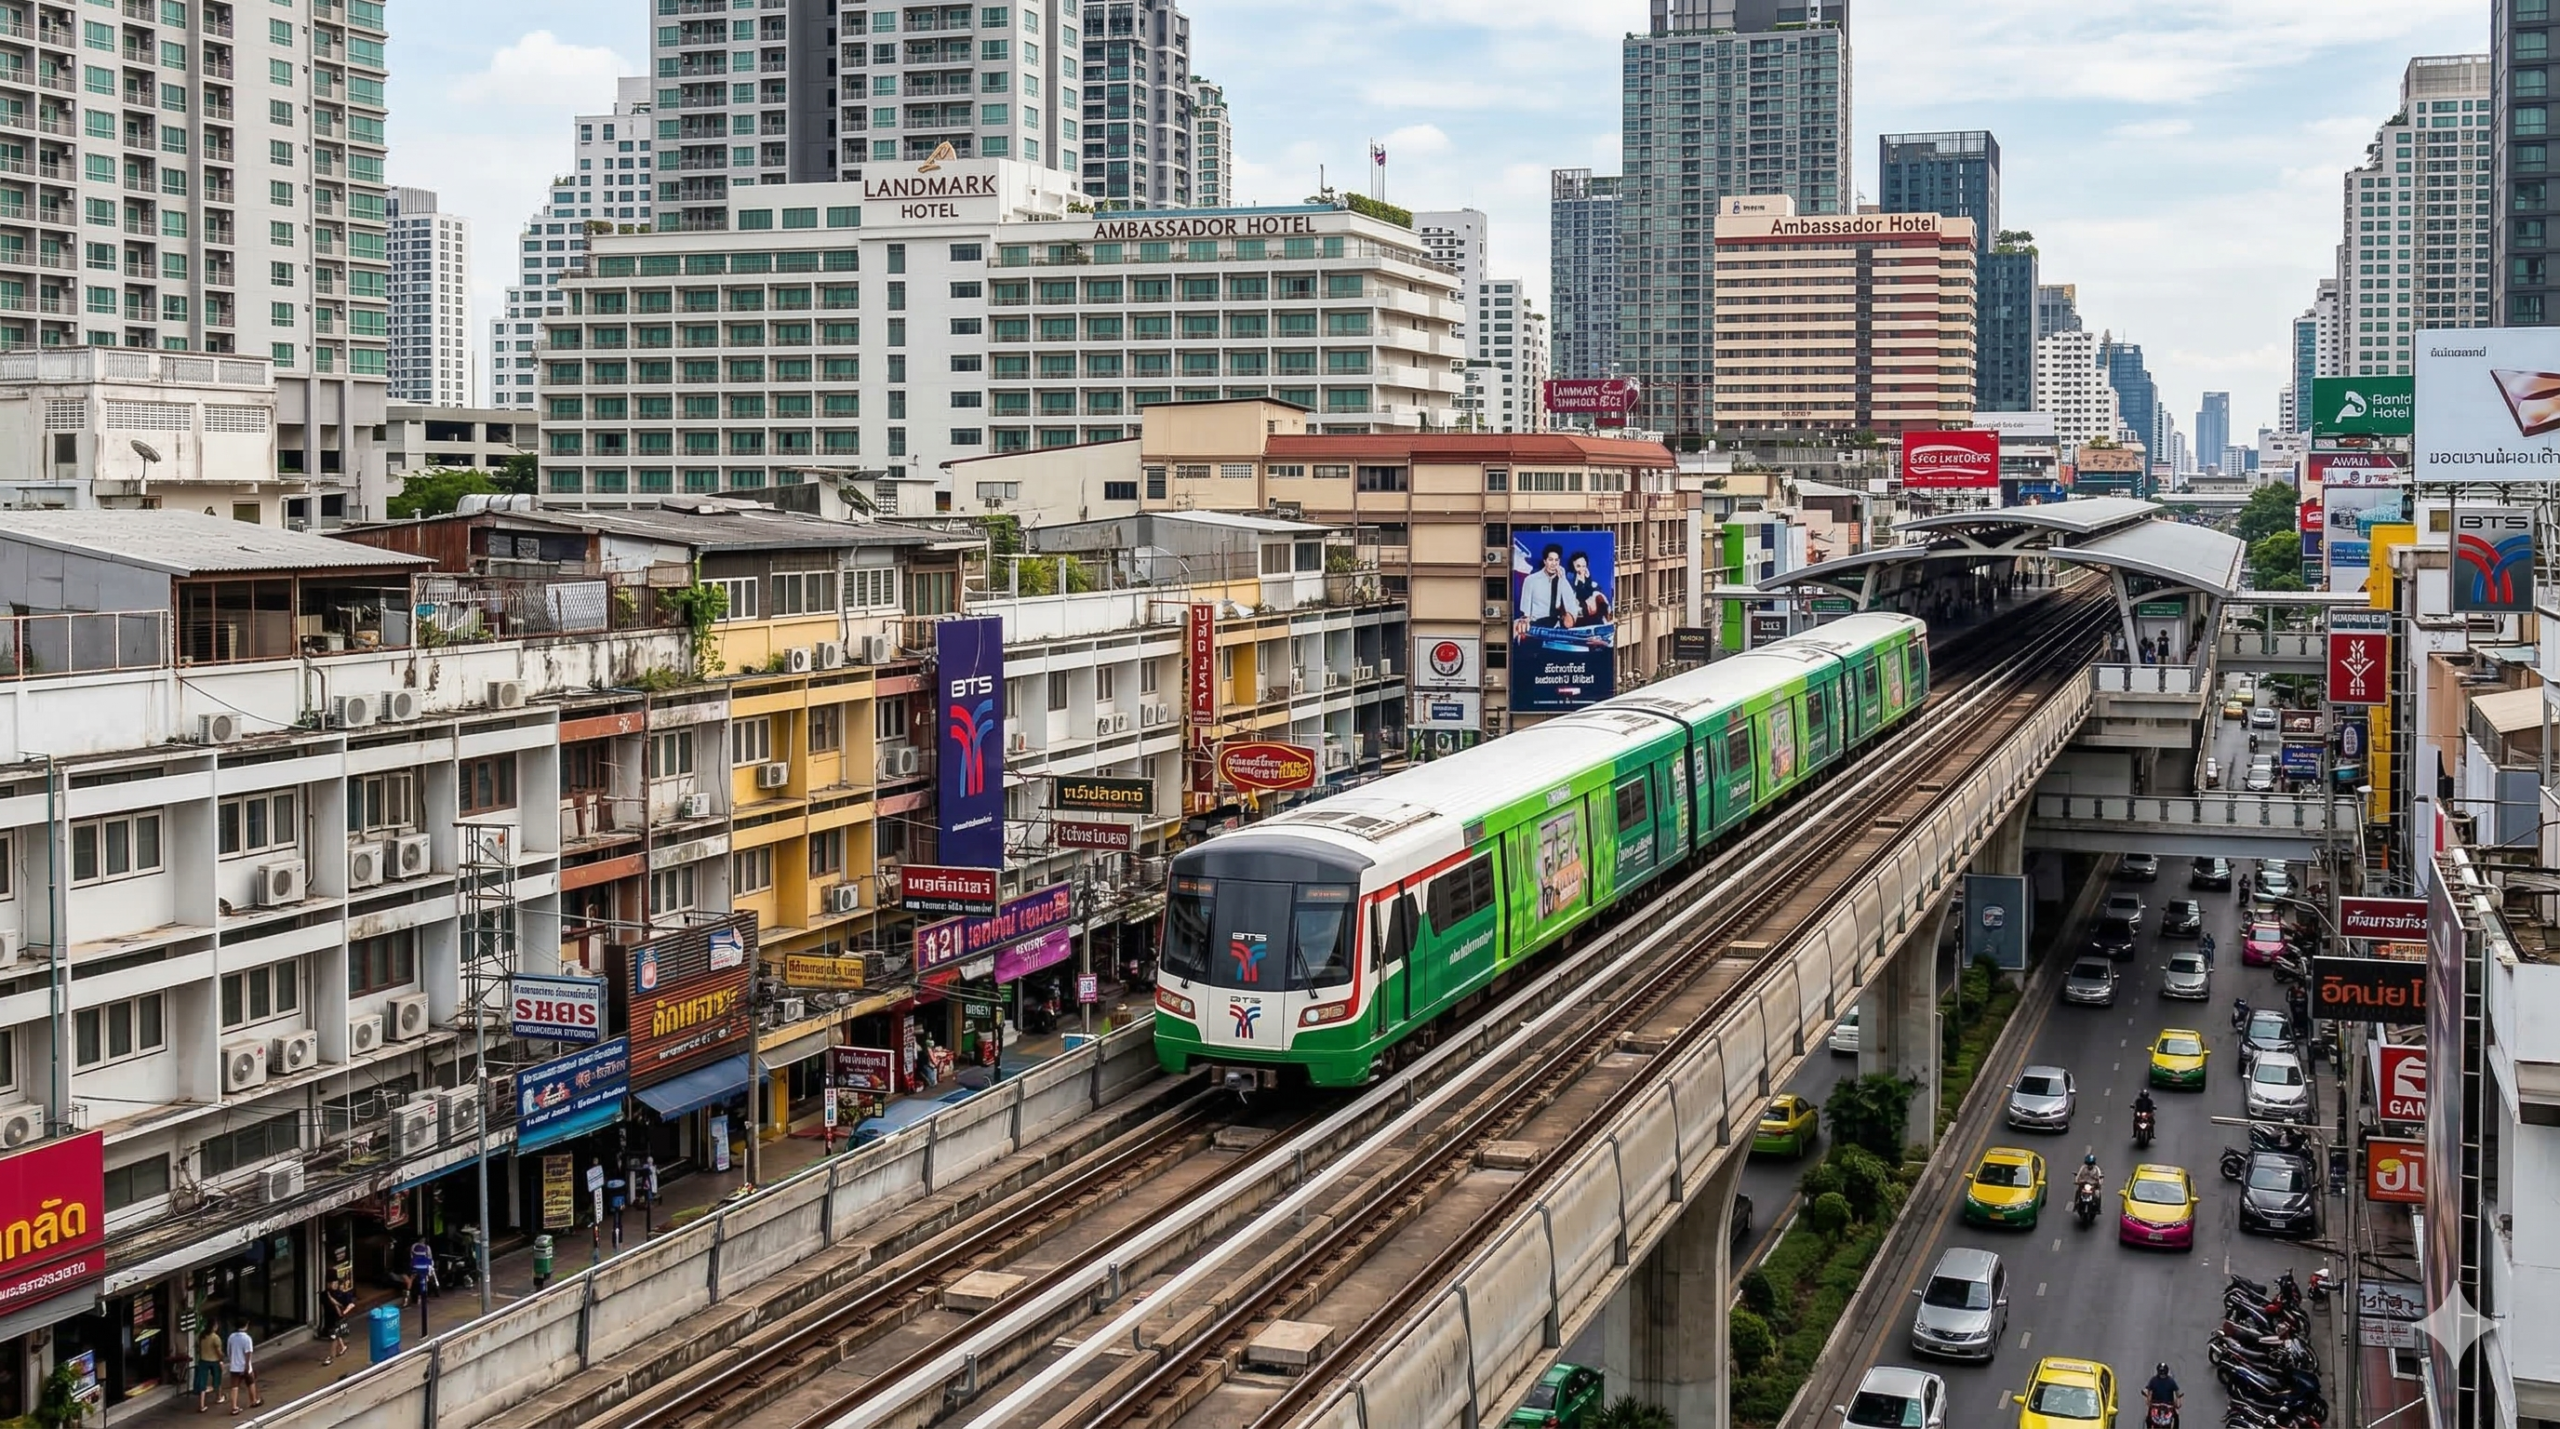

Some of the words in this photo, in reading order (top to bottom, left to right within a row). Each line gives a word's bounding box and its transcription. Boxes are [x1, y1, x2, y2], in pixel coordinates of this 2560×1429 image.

[864, 174, 996, 198] LANDMARK
[901, 203, 959, 219] HOTEL
[1093, 218, 1238, 239] AMBASSADOR
[1248, 216, 1317, 234] HOTEL
[1770, 217, 1883, 235] Ambassador
[1889, 215, 1936, 232] Hotel
[2372, 406, 2410, 418] Hotel
[2459, 515, 2529, 529] BTS
[951, 675, 993, 698] BTS
[1232, 932, 1267, 942] BTS
[0, 1198, 86, 1262] กลัด
